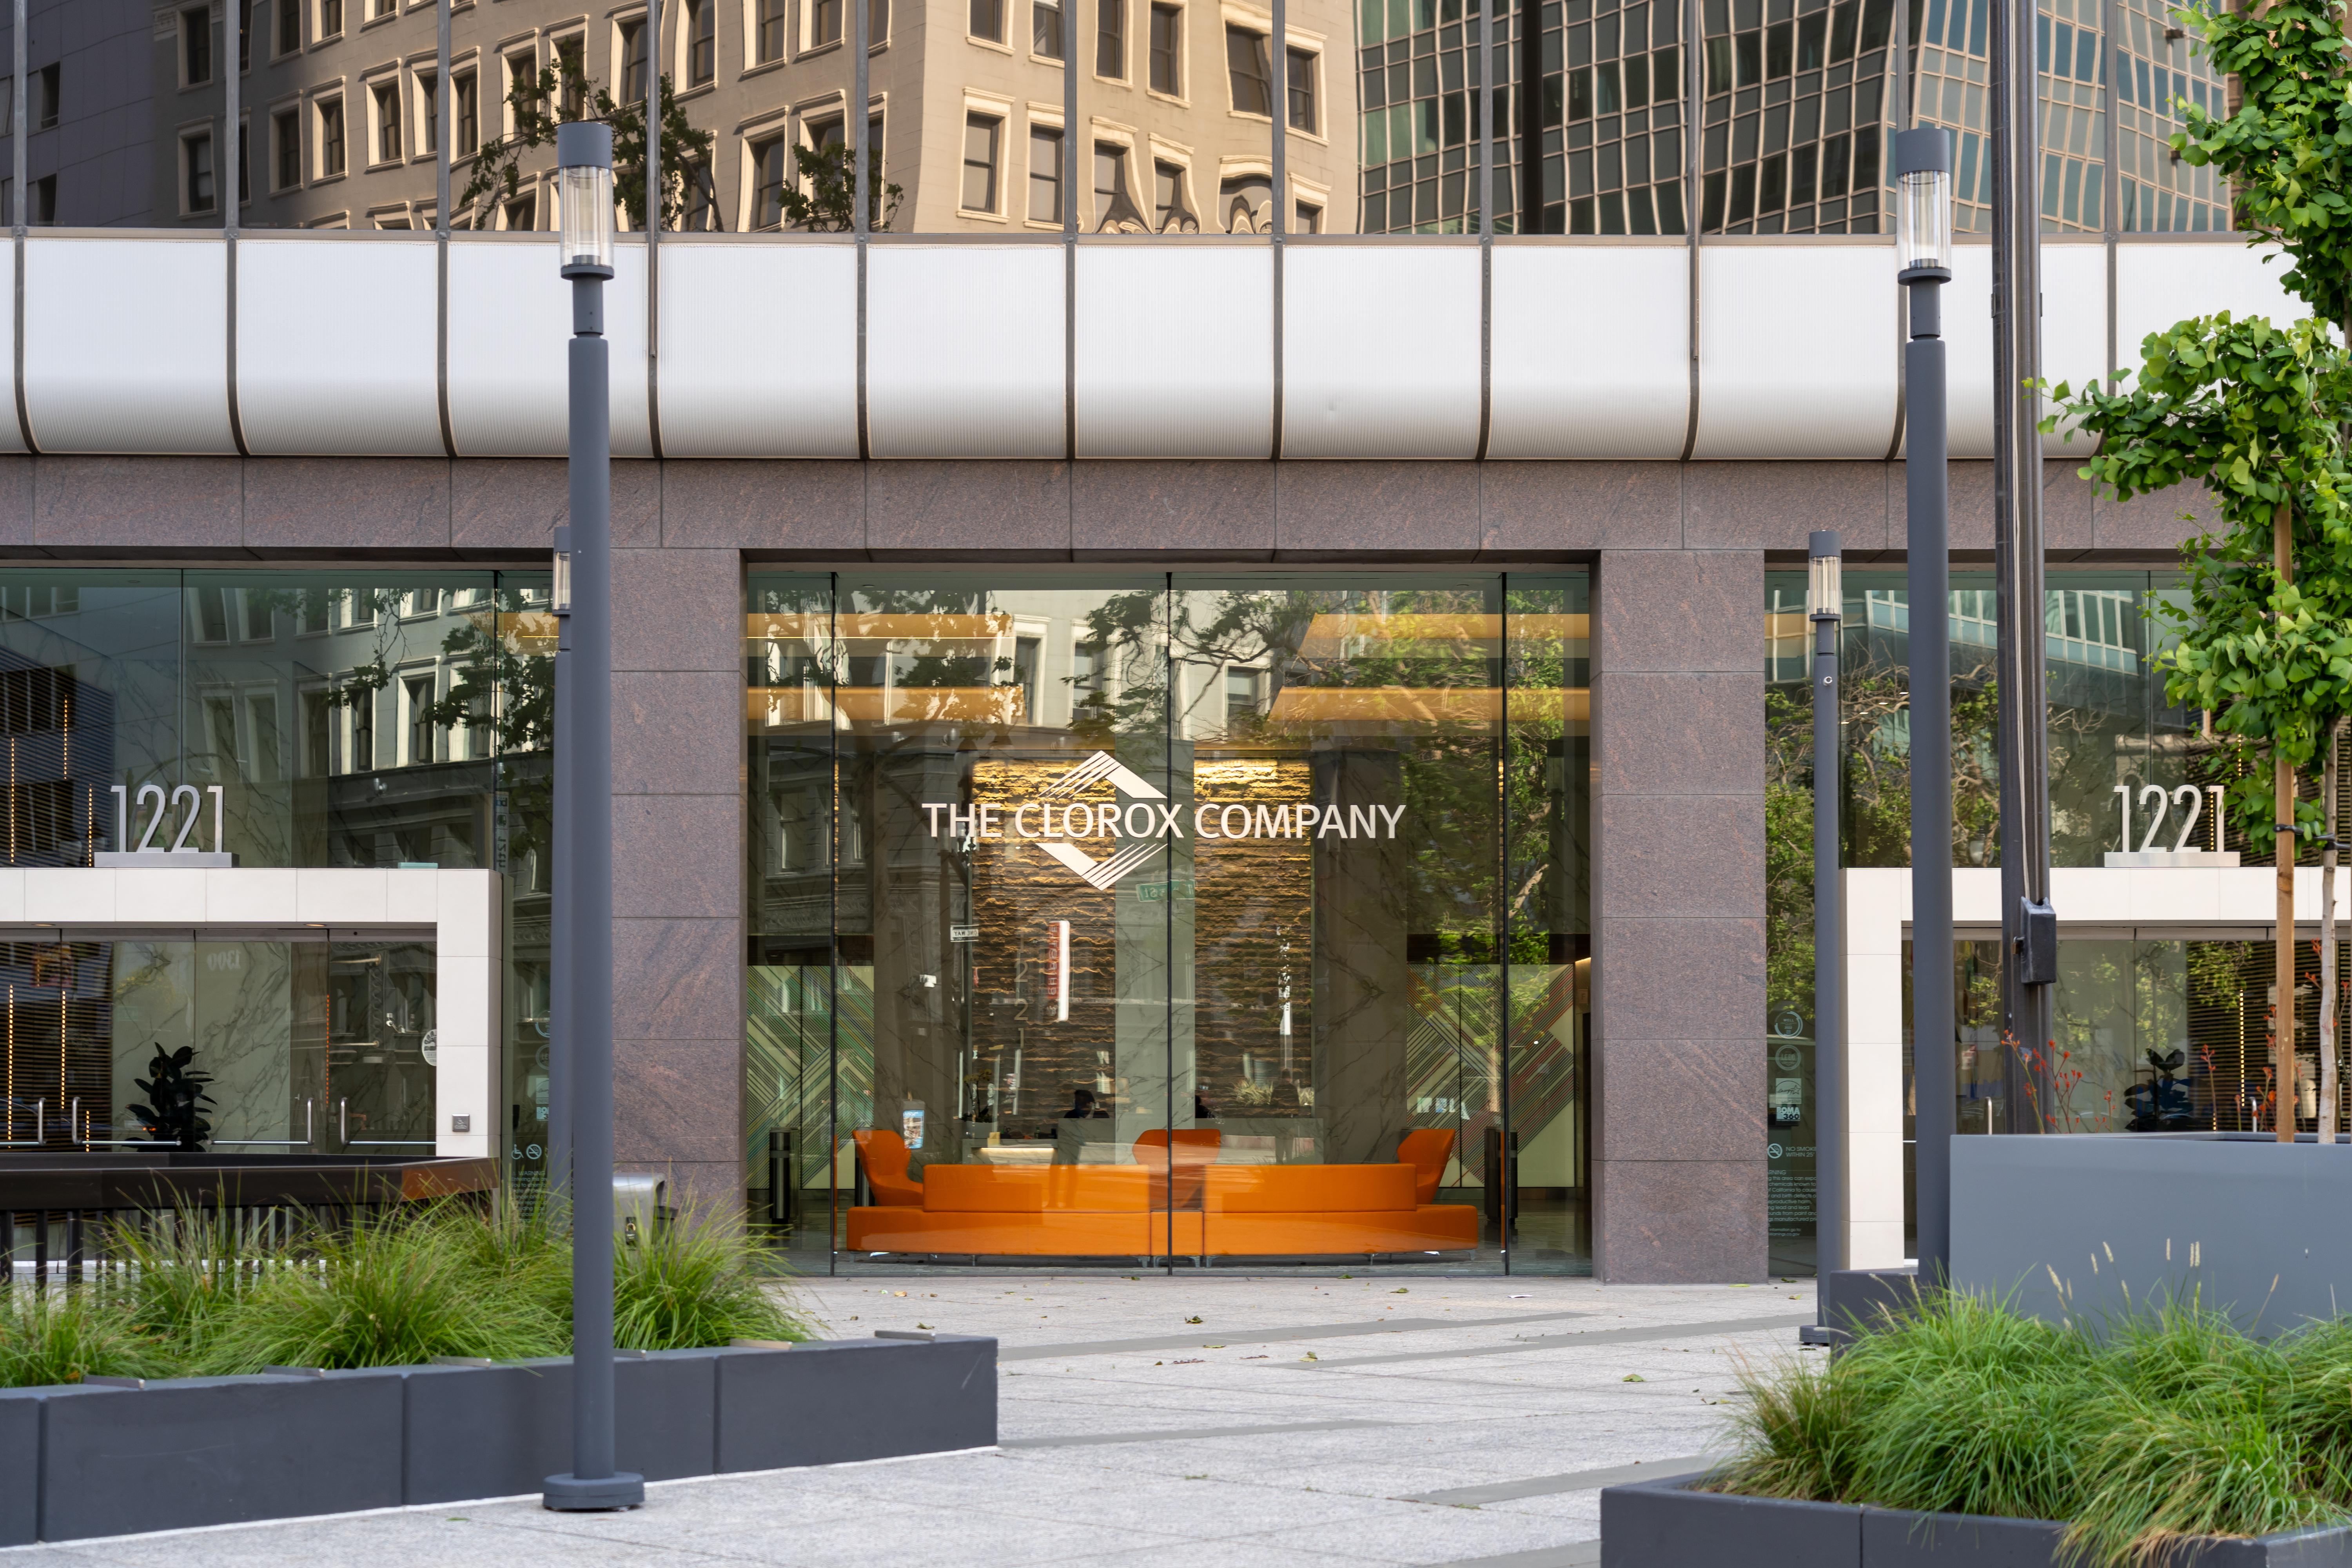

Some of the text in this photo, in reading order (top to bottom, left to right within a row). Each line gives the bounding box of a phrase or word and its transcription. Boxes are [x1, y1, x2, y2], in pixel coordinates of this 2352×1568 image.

[111, 784, 224, 853] 1221
[922, 802, 1406, 839] THE CLOROX COMPANY
[2113, 784, 2225, 853] 1221
